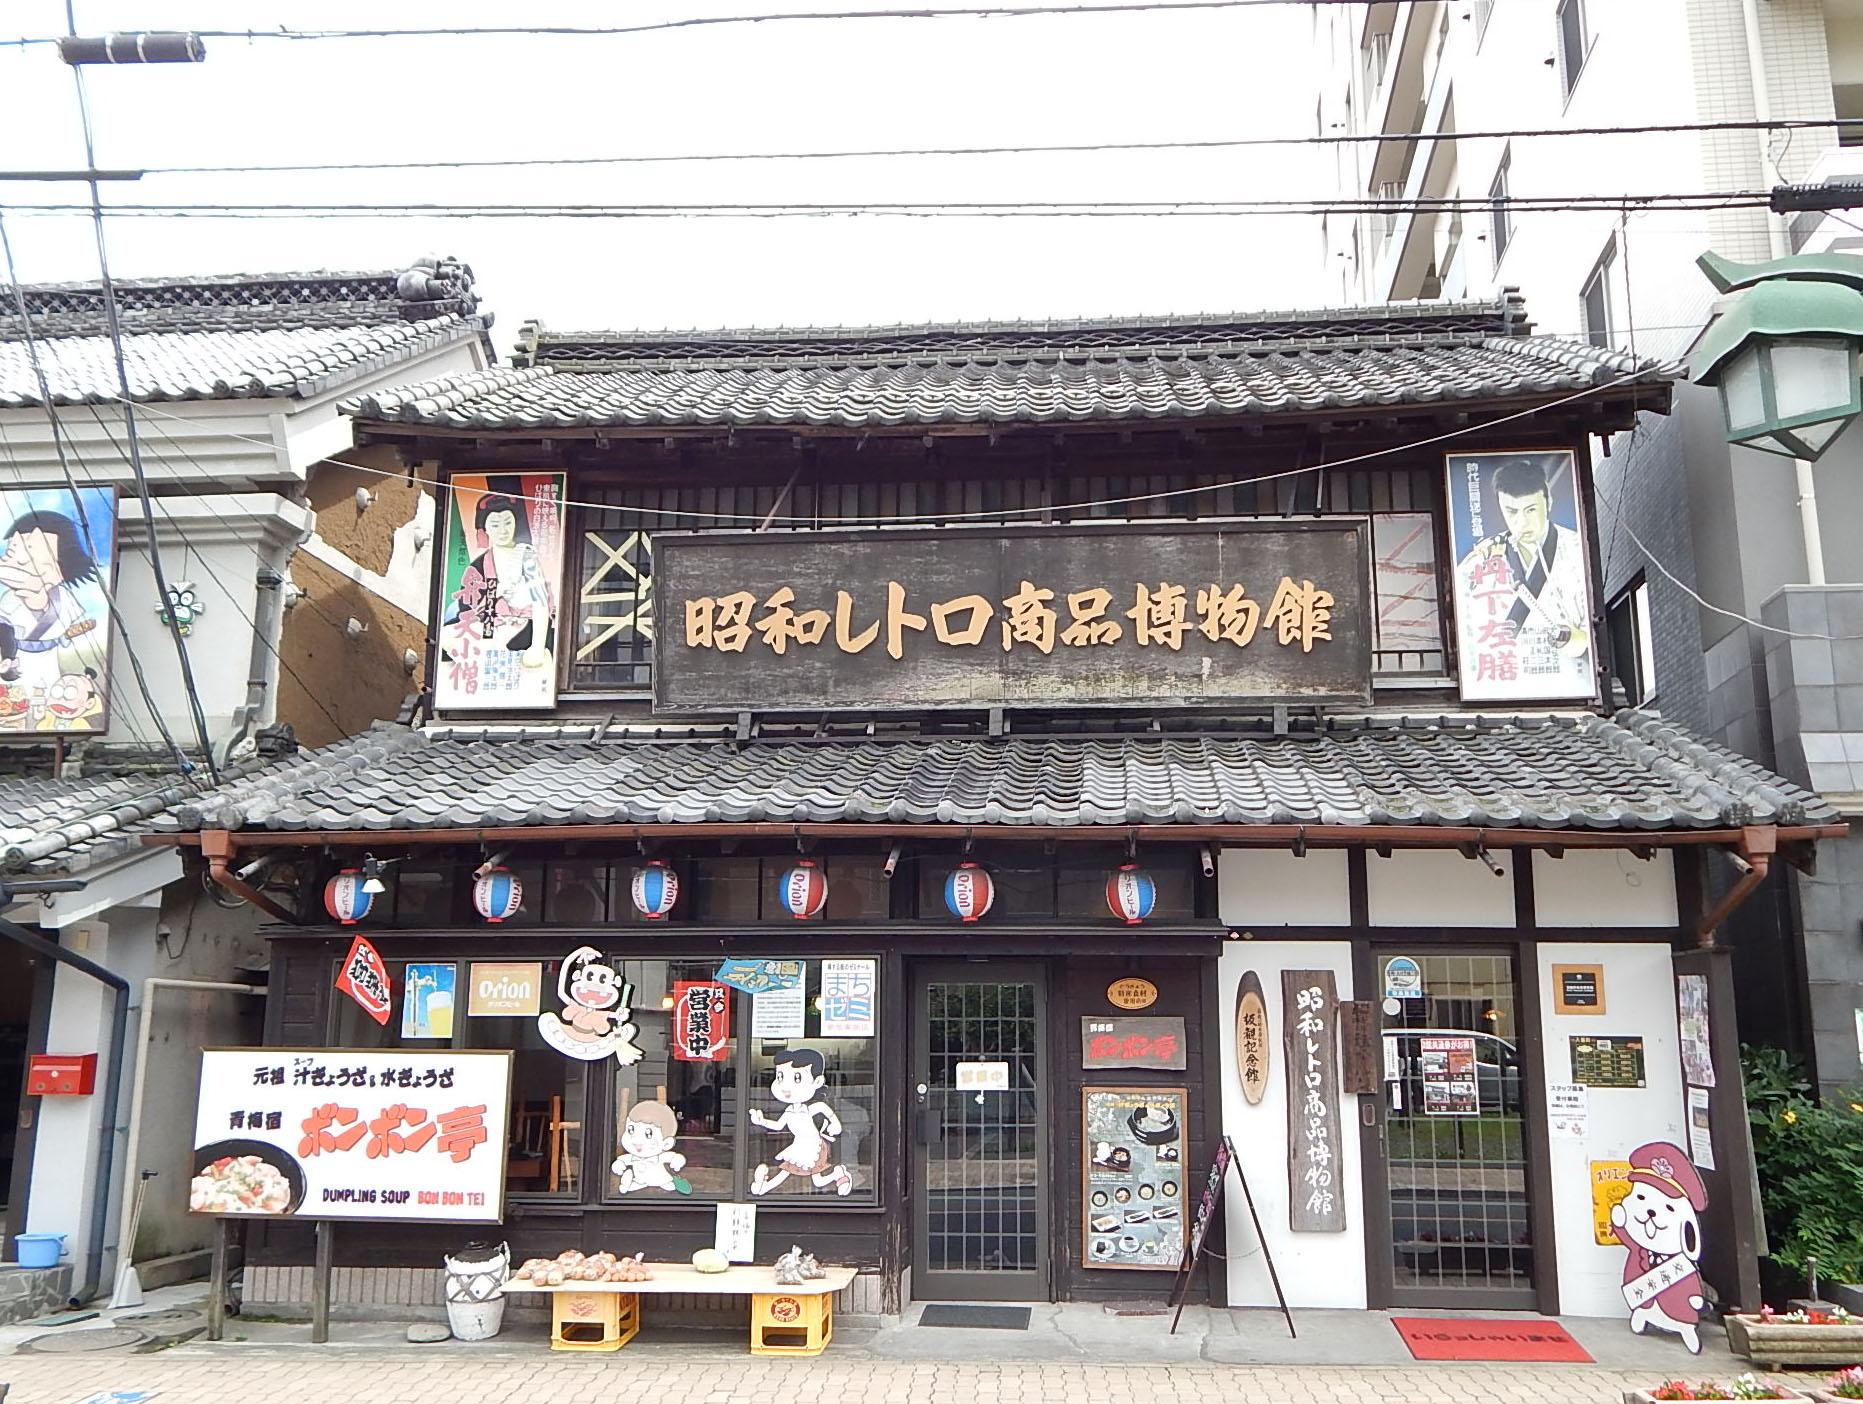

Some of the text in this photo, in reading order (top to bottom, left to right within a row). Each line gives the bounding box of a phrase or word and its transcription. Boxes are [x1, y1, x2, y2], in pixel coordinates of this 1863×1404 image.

[449, 565, 487, 696] 弁天小僧
[684, 576, 1334, 660] 昭和レトロ商品博物館
[1469, 557, 1518, 682] 丹下左膳
[688, 988, 711, 1056] 営業中
[253, 1066, 285, 1086] 元祖
[1297, 987, 1334, 1216] 昭和レトロ商品博物館
[229, 1110, 282, 1131] 青梅宿
[322, 1188, 484, 1206] DUMPLING SOUP BON BON TEI
